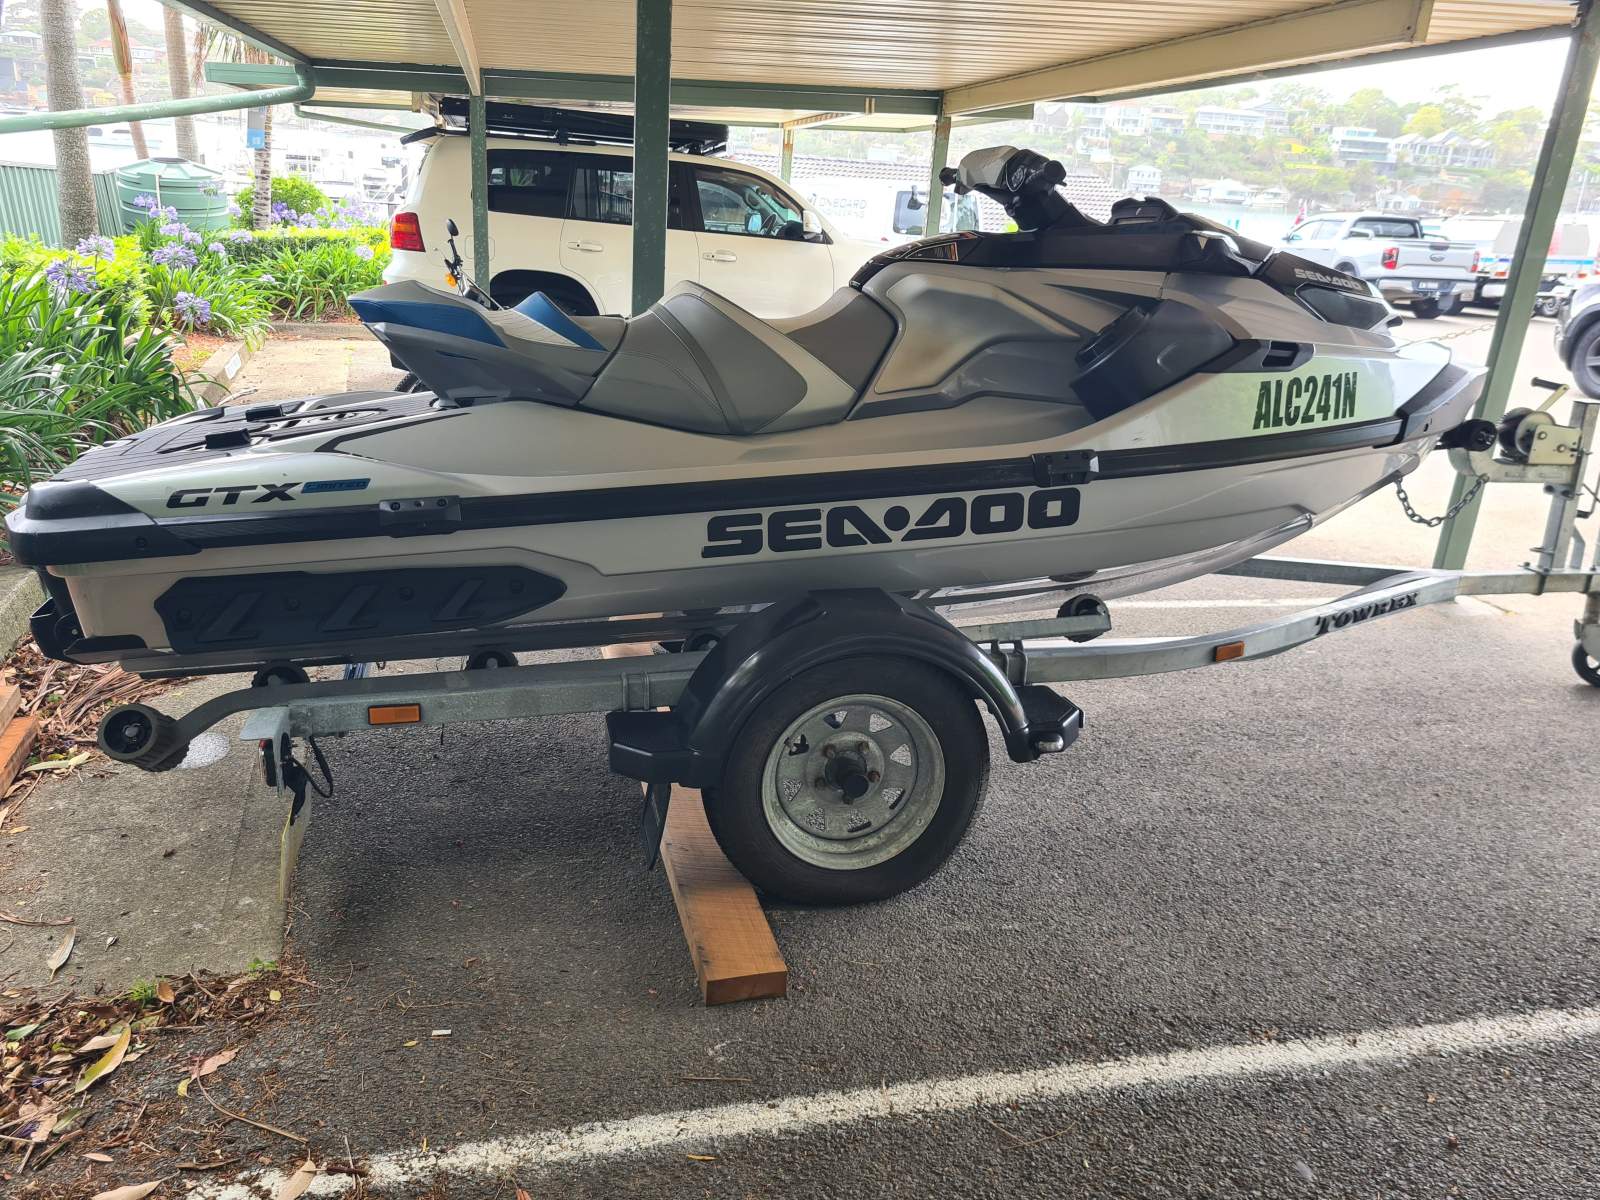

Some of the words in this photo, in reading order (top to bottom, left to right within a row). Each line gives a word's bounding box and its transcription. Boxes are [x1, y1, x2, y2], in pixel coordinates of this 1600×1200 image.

[1252, 371, 1358, 430] ALC241N
[166, 482, 303, 509] GTX
[1314, 592, 1419, 636] TOWREX
